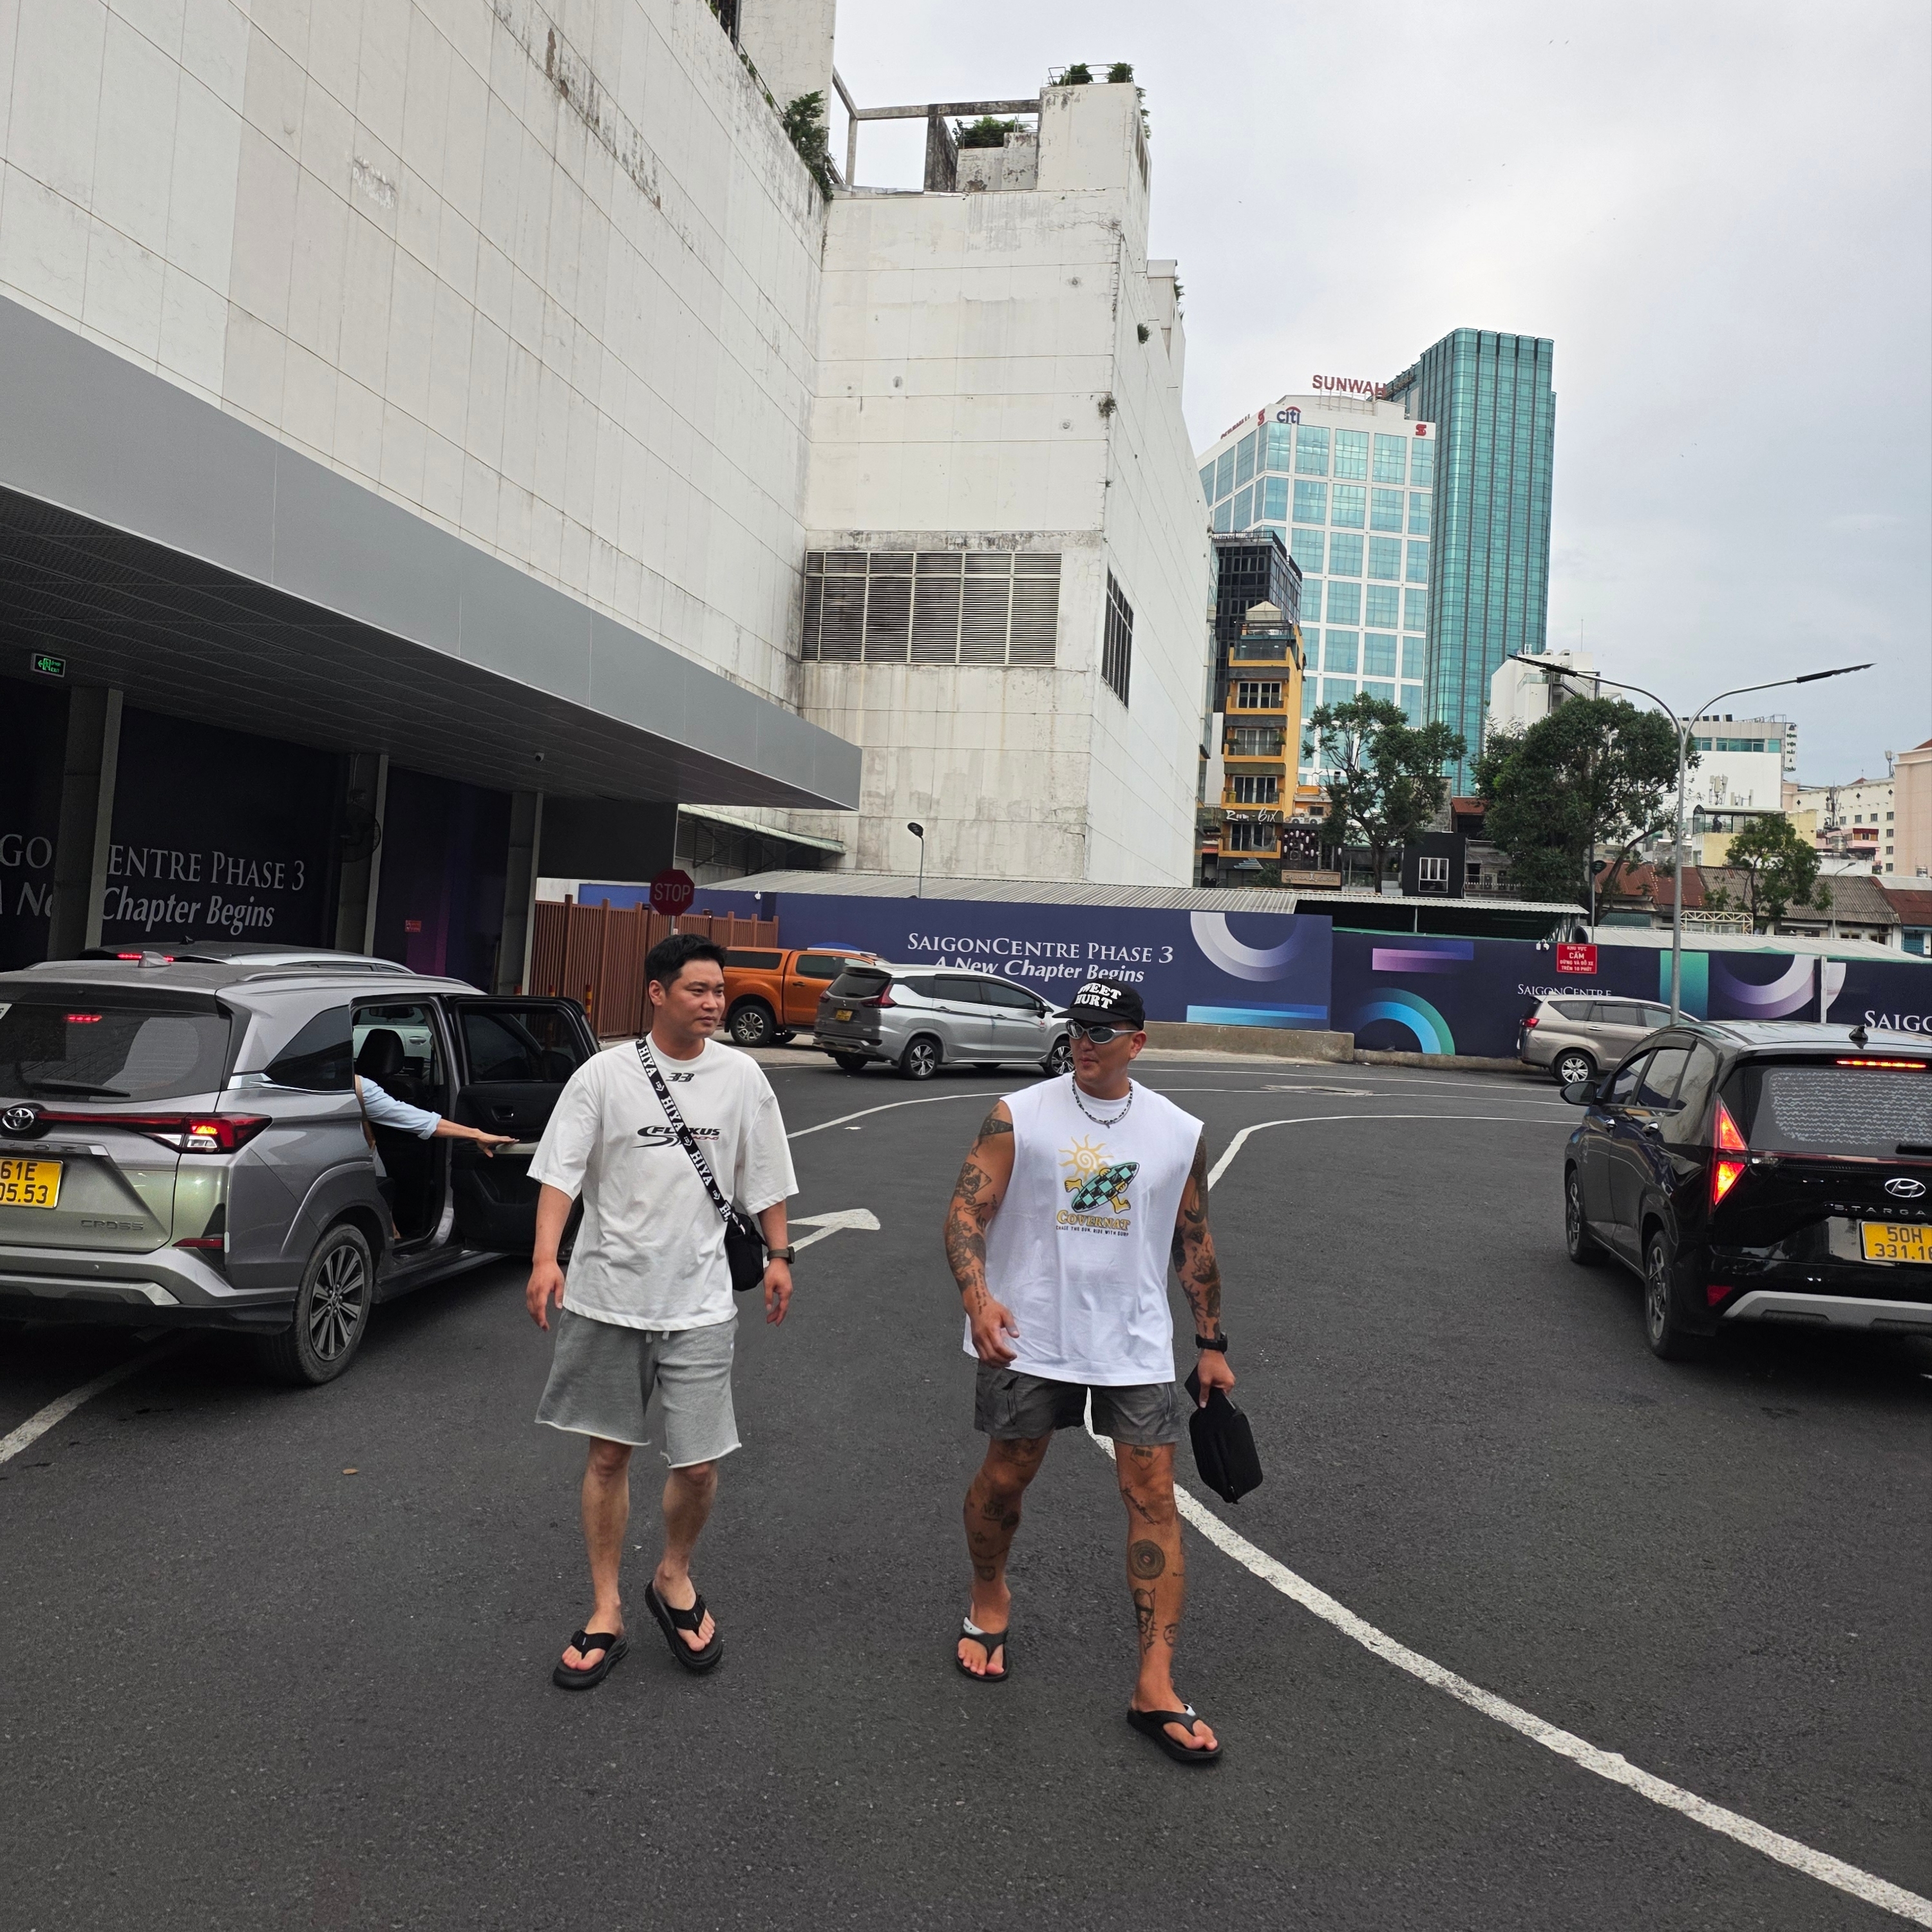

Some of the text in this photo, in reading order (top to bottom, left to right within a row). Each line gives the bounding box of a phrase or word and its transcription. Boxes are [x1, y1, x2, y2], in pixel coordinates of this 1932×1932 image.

[1312, 375, 1387, 395] SUNWAH
[1276, 406, 1301, 425] citi
[211, 851, 285, 889] PHASE
[292, 860, 305, 891] 3
[654, 883, 691, 902] STOP
[102, 886, 201, 932] Chapter
[206, 895, 275, 935] Begins
[1086, 942, 1153, 963] PHASE
[1159, 945, 1174, 964] 3
[954, 957, 999, 974] New
[1004, 960, 1082, 982] Chapter
[1087, 963, 1145, 983] Begins
[1074, 994, 1113, 1009] HURT
[638, 1045, 658, 1077] HIYA
[665, 1072, 696, 1083] 33
[661, 1095, 685, 1132] HIYA
[1, 1160, 37, 1181] 61E
[690, 1150, 714, 1186] HIYA
[81, 1220, 144, 1231] CROSS
[1056, 1209, 1131, 1231] COVERNAT
[1887, 1226, 1923, 1244] 50H
